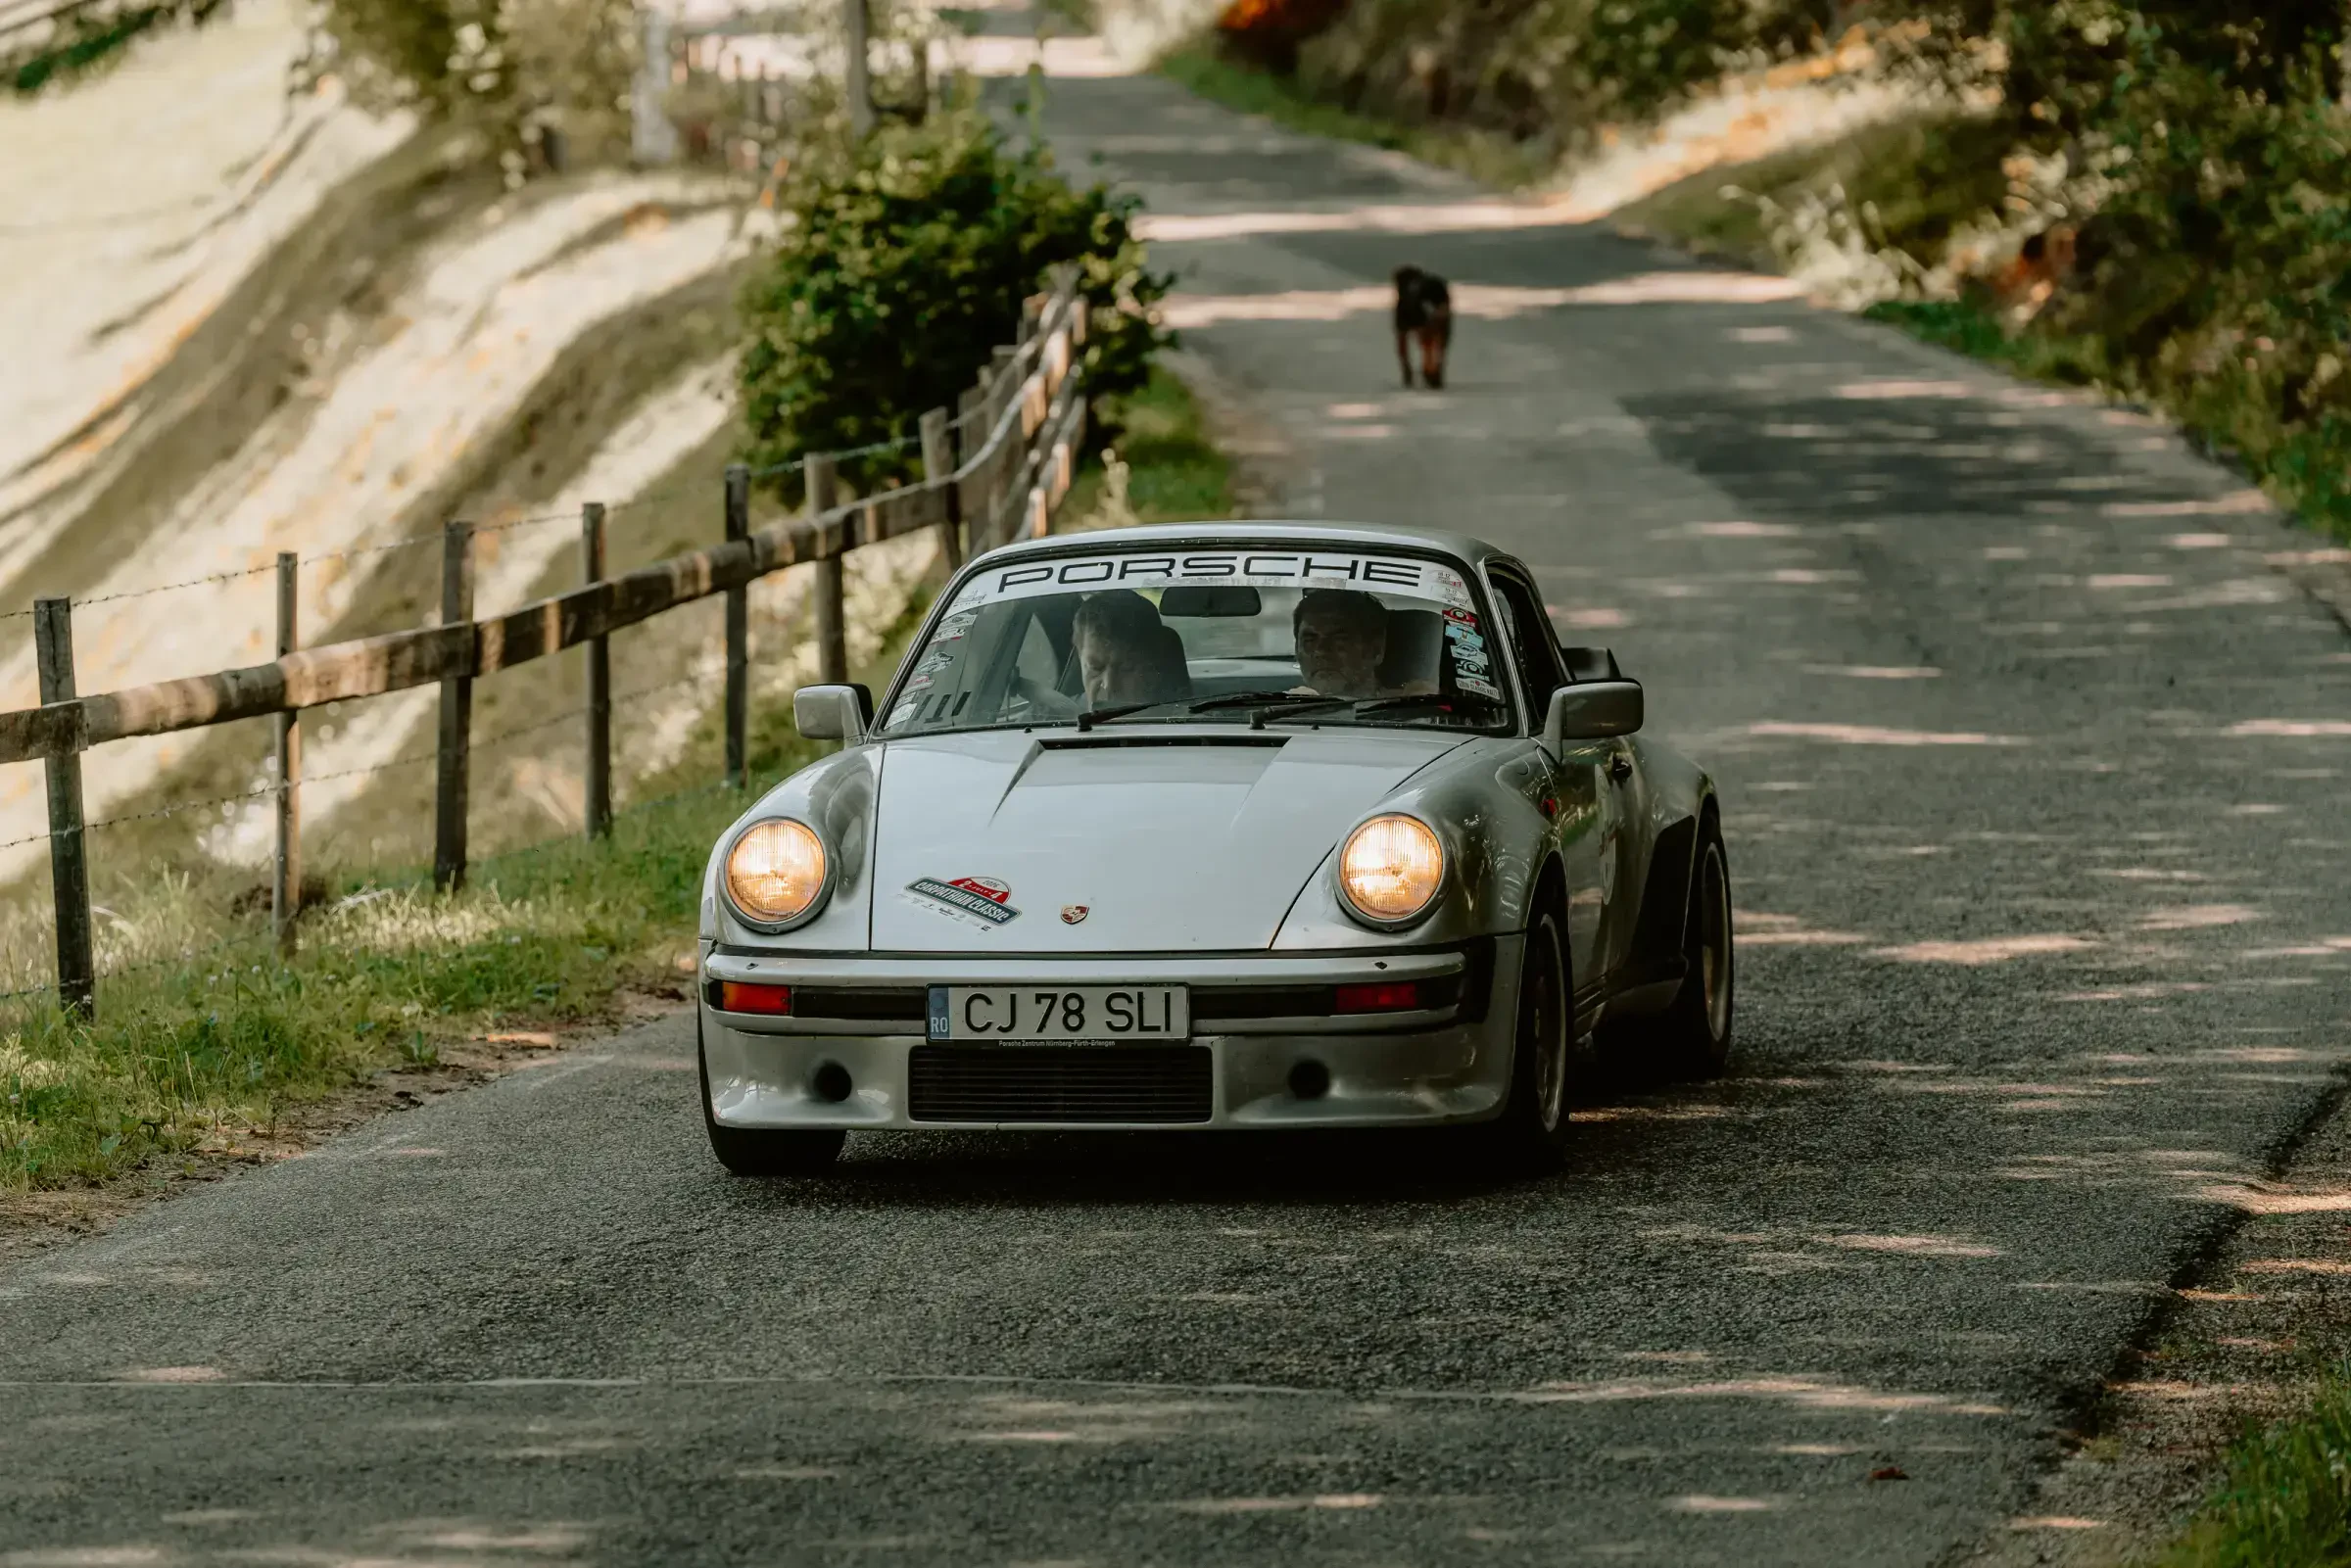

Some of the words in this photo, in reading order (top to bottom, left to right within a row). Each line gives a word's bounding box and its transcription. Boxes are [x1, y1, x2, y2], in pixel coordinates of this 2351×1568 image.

[997, 555, 1422, 594] PORSCHE
[915, 881, 976, 905] CARPATHIAN
[968, 899, 1009, 921] CLASSIC
[931, 1017, 948, 1033] RO
[965, 992, 1017, 1033] CJ
[1035, 992, 1085, 1033] 78
[1105, 991, 1171, 1032] SLI
